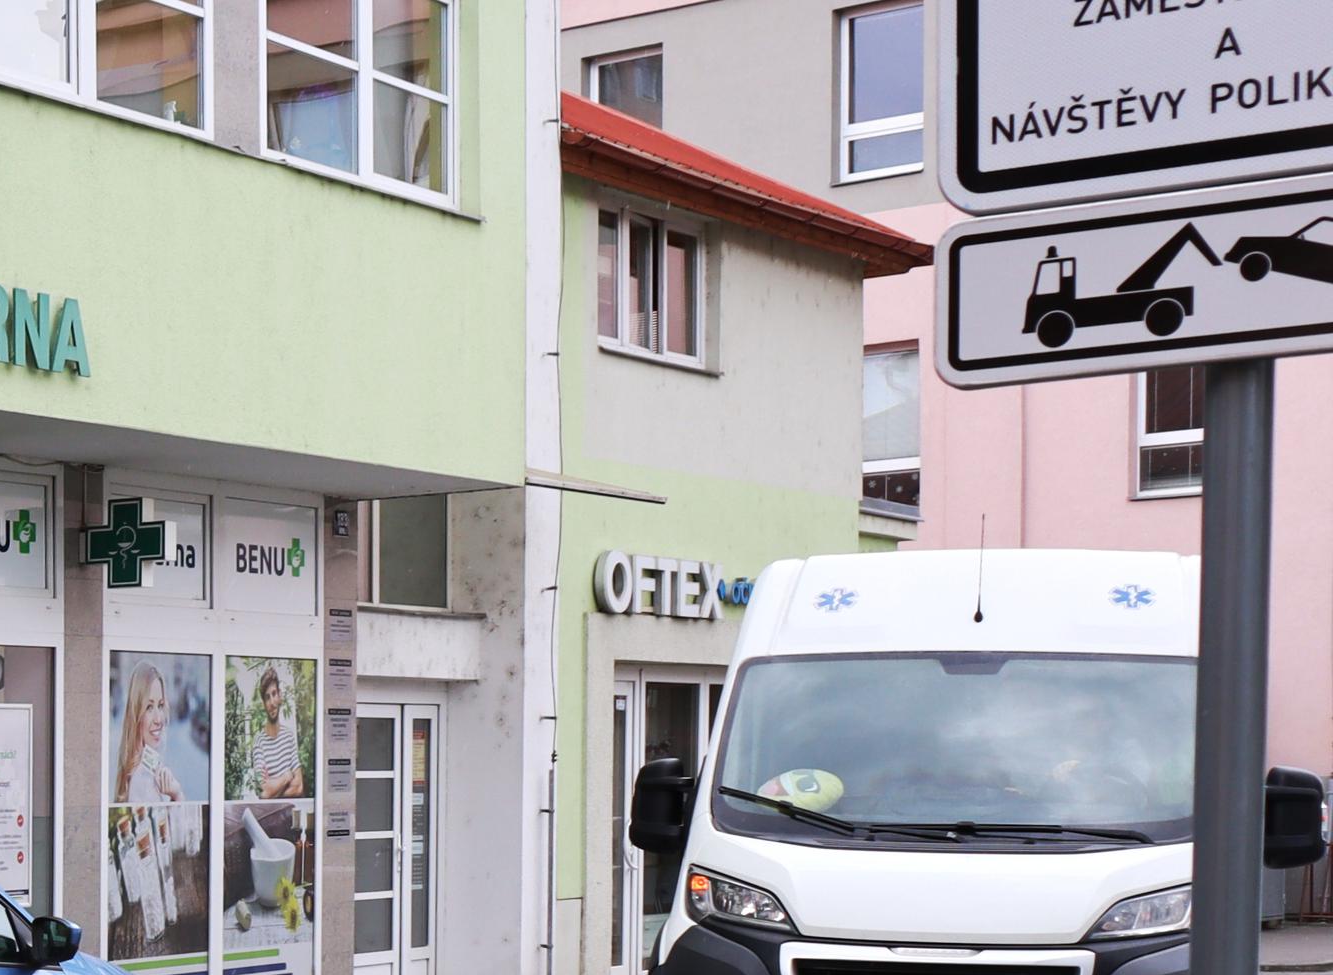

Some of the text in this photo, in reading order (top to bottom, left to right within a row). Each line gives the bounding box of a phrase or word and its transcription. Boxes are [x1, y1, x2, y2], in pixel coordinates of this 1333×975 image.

[1215, 26, 1242, 60] A
[990, 87, 1187, 145] NÁVŠTĚVY
[236, 543, 285, 576] BENU
[594, 550, 724, 619] OFTEX
